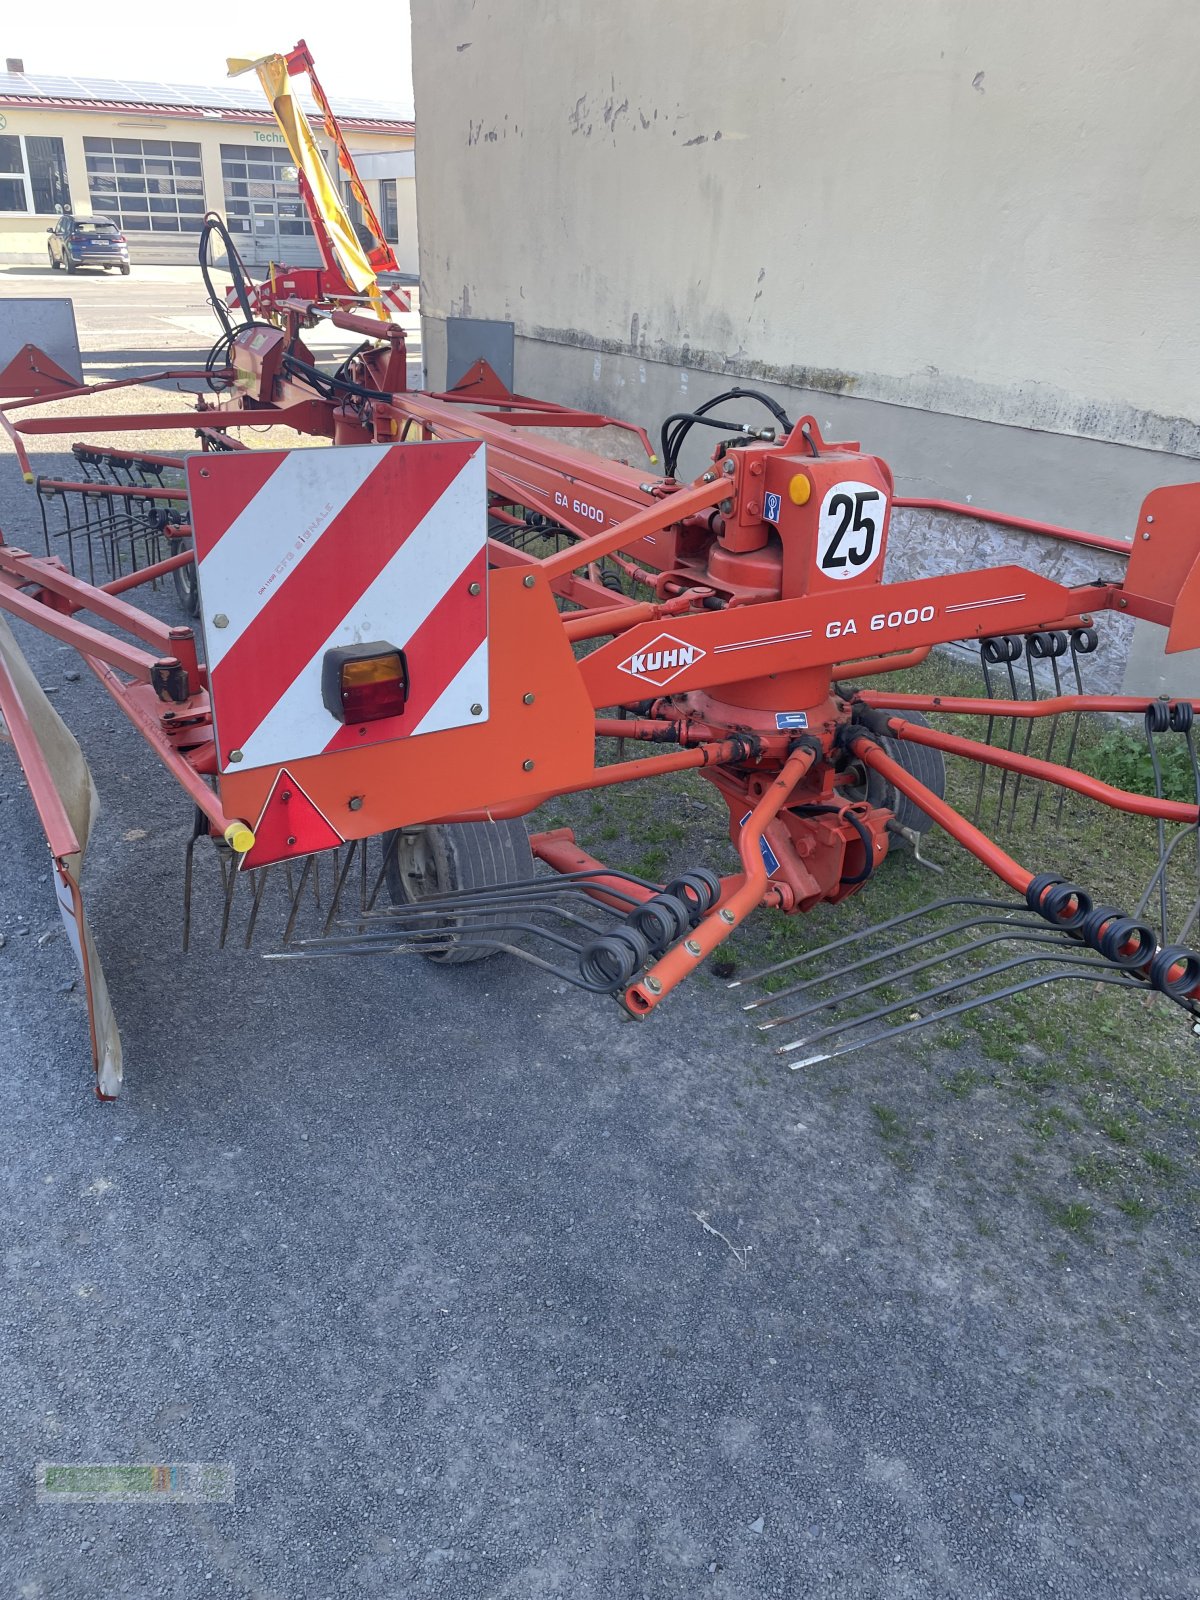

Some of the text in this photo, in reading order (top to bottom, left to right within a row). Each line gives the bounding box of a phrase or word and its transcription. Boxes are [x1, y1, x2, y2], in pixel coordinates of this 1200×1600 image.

[555, 491, 604, 523] GA 6000
[822, 491, 880, 568] 25
[825, 605, 935, 639] GA 6000
[631, 646, 694, 674] KUHN
